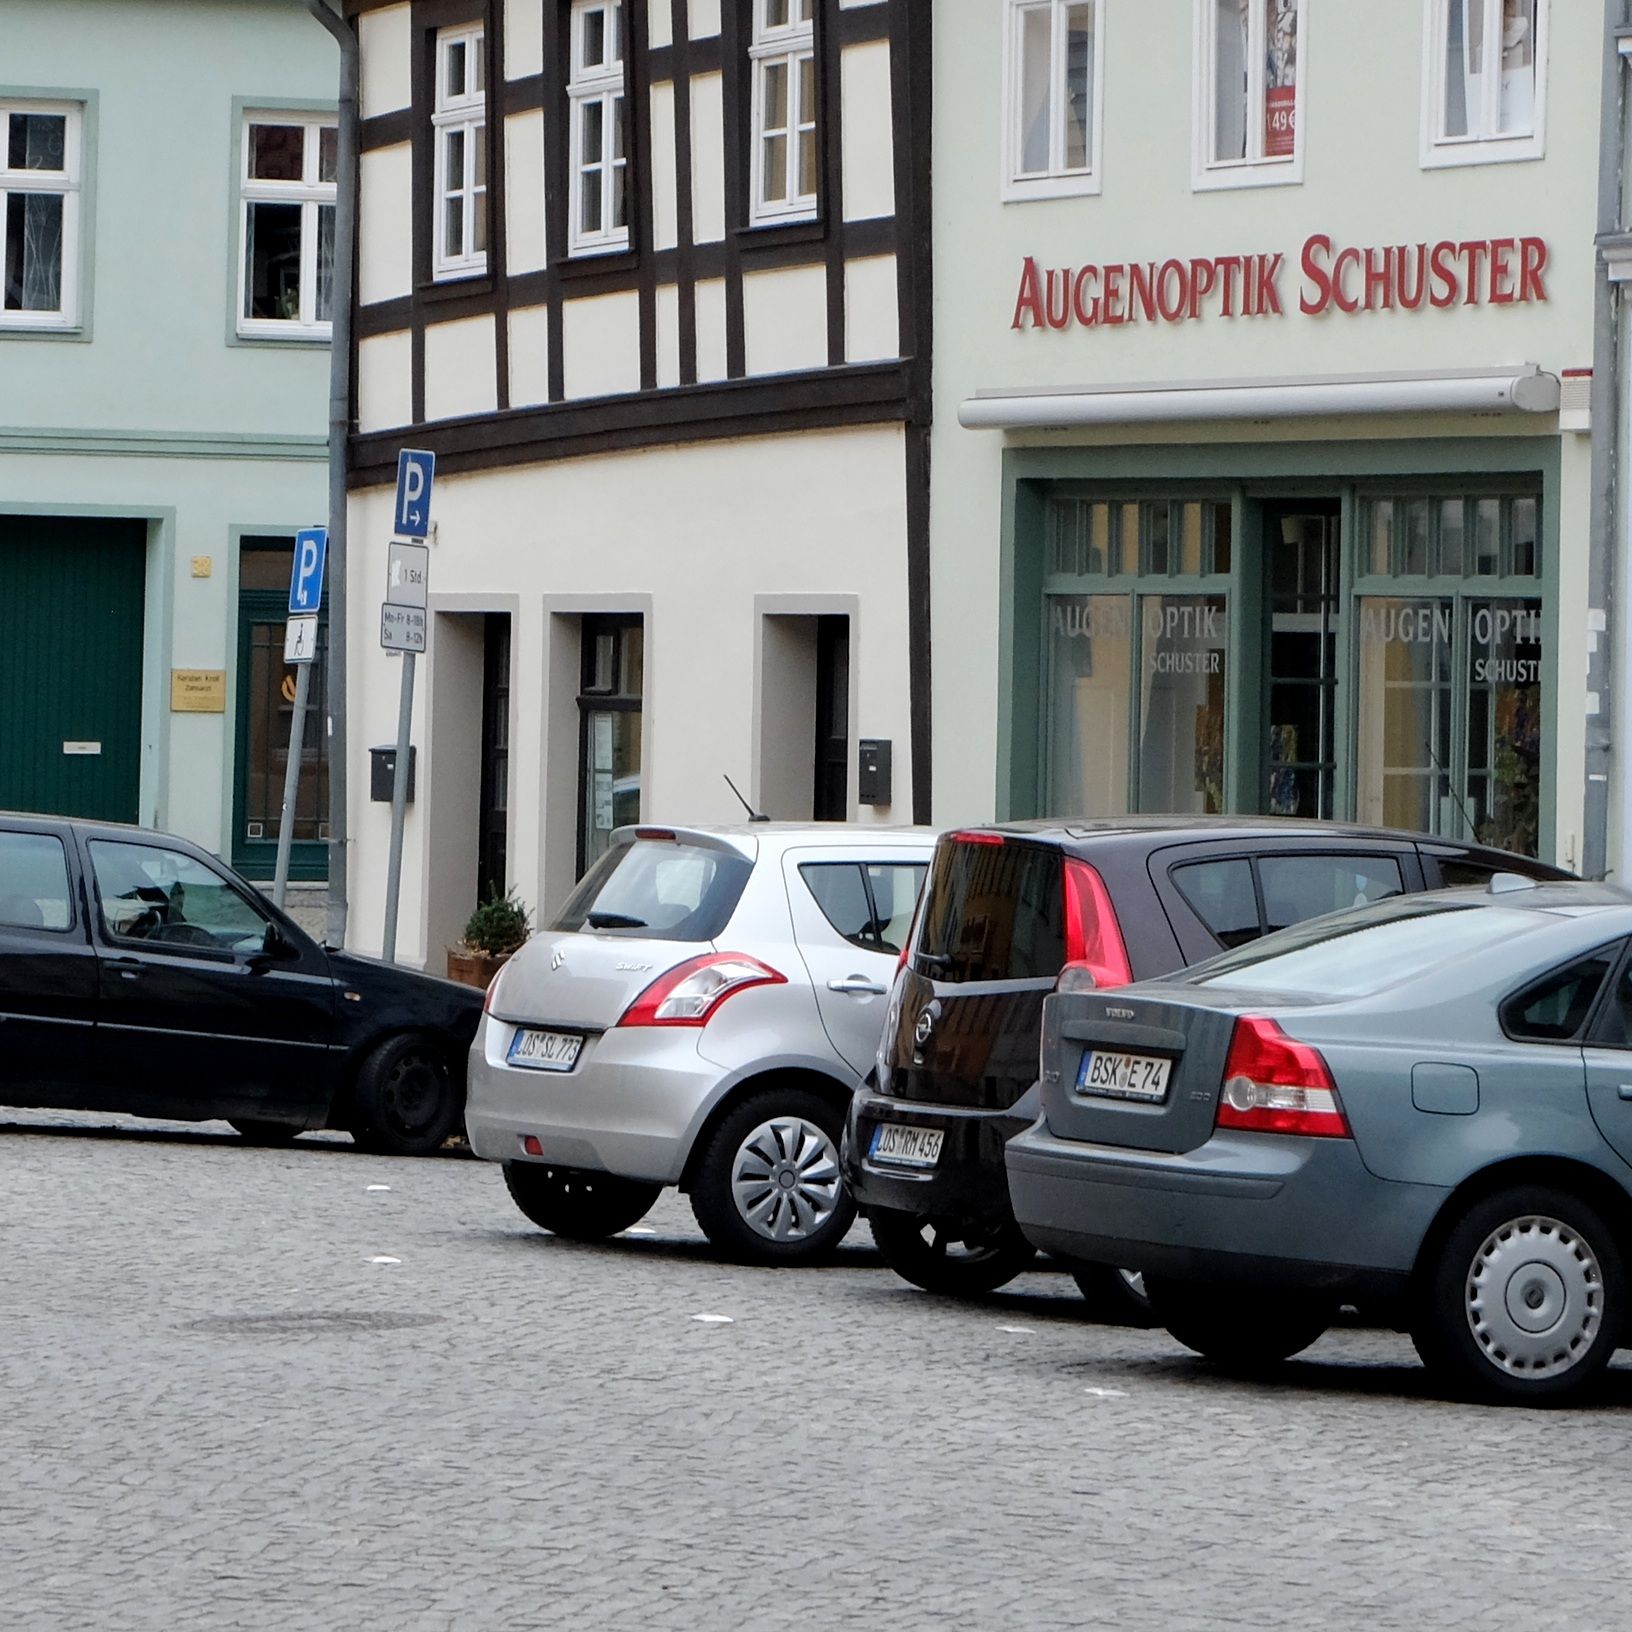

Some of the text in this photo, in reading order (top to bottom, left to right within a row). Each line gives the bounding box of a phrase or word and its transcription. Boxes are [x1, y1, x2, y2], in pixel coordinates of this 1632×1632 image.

[1010, 233, 1548, 330] AUGENOPTIK SCHUSTER
[402, 461, 424, 525] P
[297, 539, 317, 601] P
[409, 569, 423, 585] Std.
[384, 611, 404, 624] Mo-Fr
[1150, 605, 1217, 639] OPTIK
[1365, 607, 1452, 644] AUGEN
[383, 628, 392, 641] Sa
[1149, 651, 1219, 674] SCHUSTER
[540, 1034, 556, 1059] SL
[555, 1035, 580, 1062] 773
[1090, 1055, 1124, 1086] BSK
[1127, 1060, 1141, 1089] E
[1141, 1061, 1163, 1091] 74
[918, 1131, 941, 1158] 456
